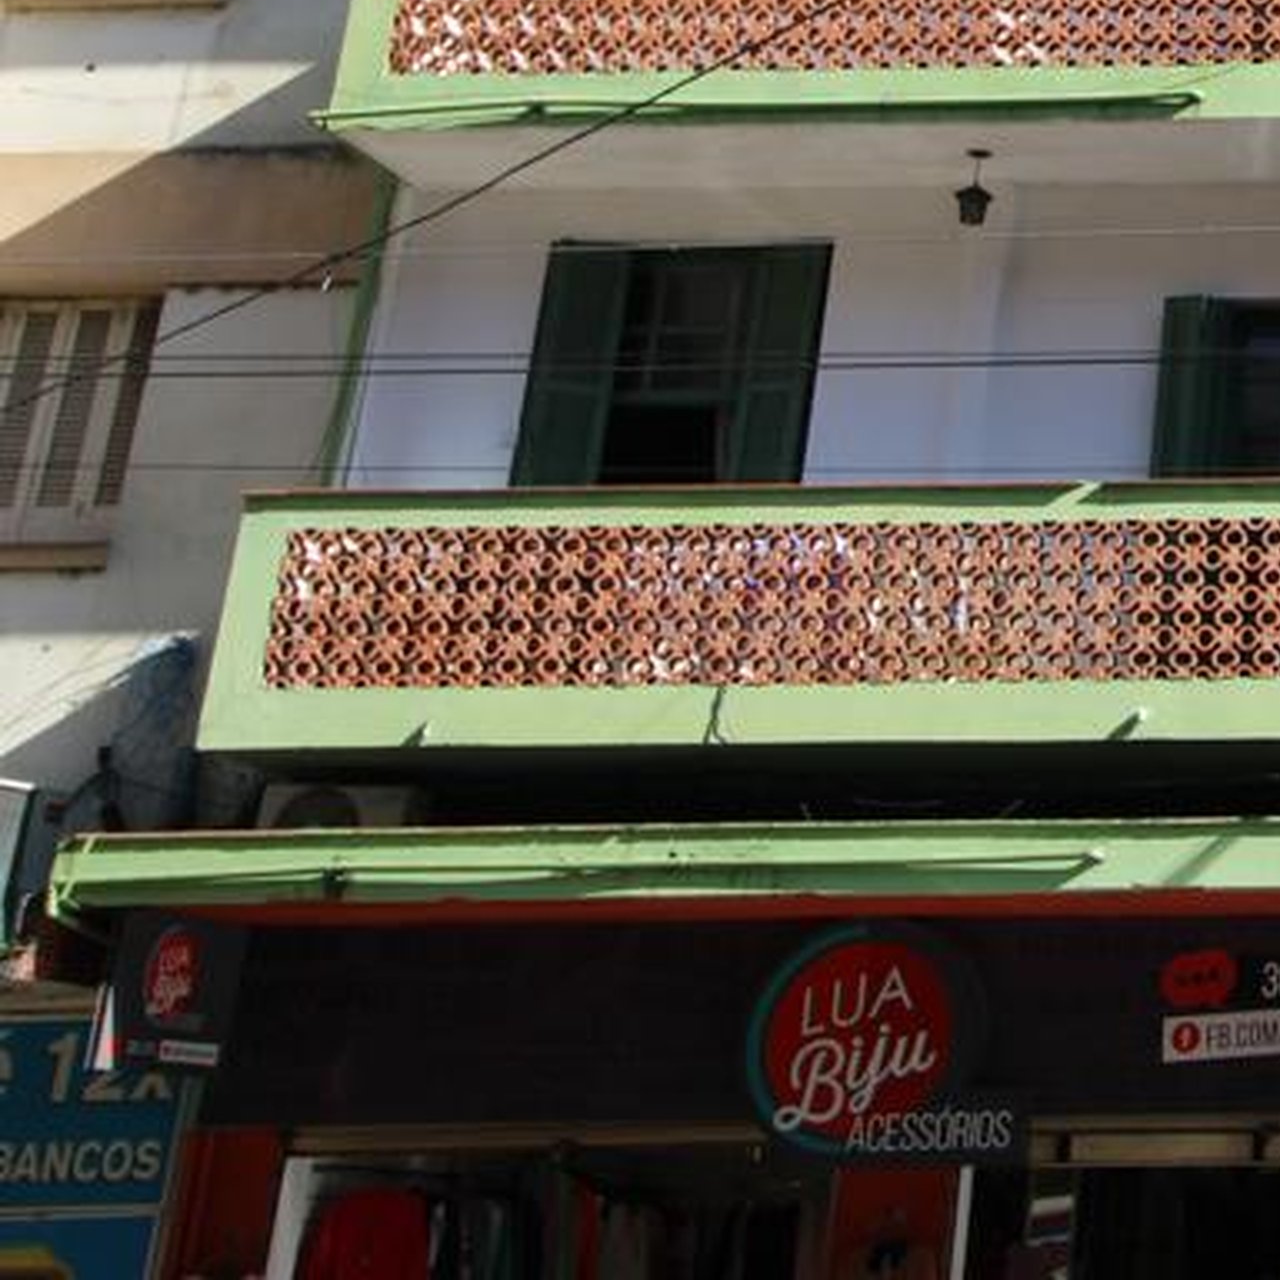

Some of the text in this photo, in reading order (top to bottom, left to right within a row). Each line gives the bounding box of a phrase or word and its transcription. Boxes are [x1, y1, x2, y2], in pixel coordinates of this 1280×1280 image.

[801, 965, 913, 1037] LUA
[772, 1023, 936, 1132] Biju
[846, 1104, 1013, 1153] ACESSÓRIOS
